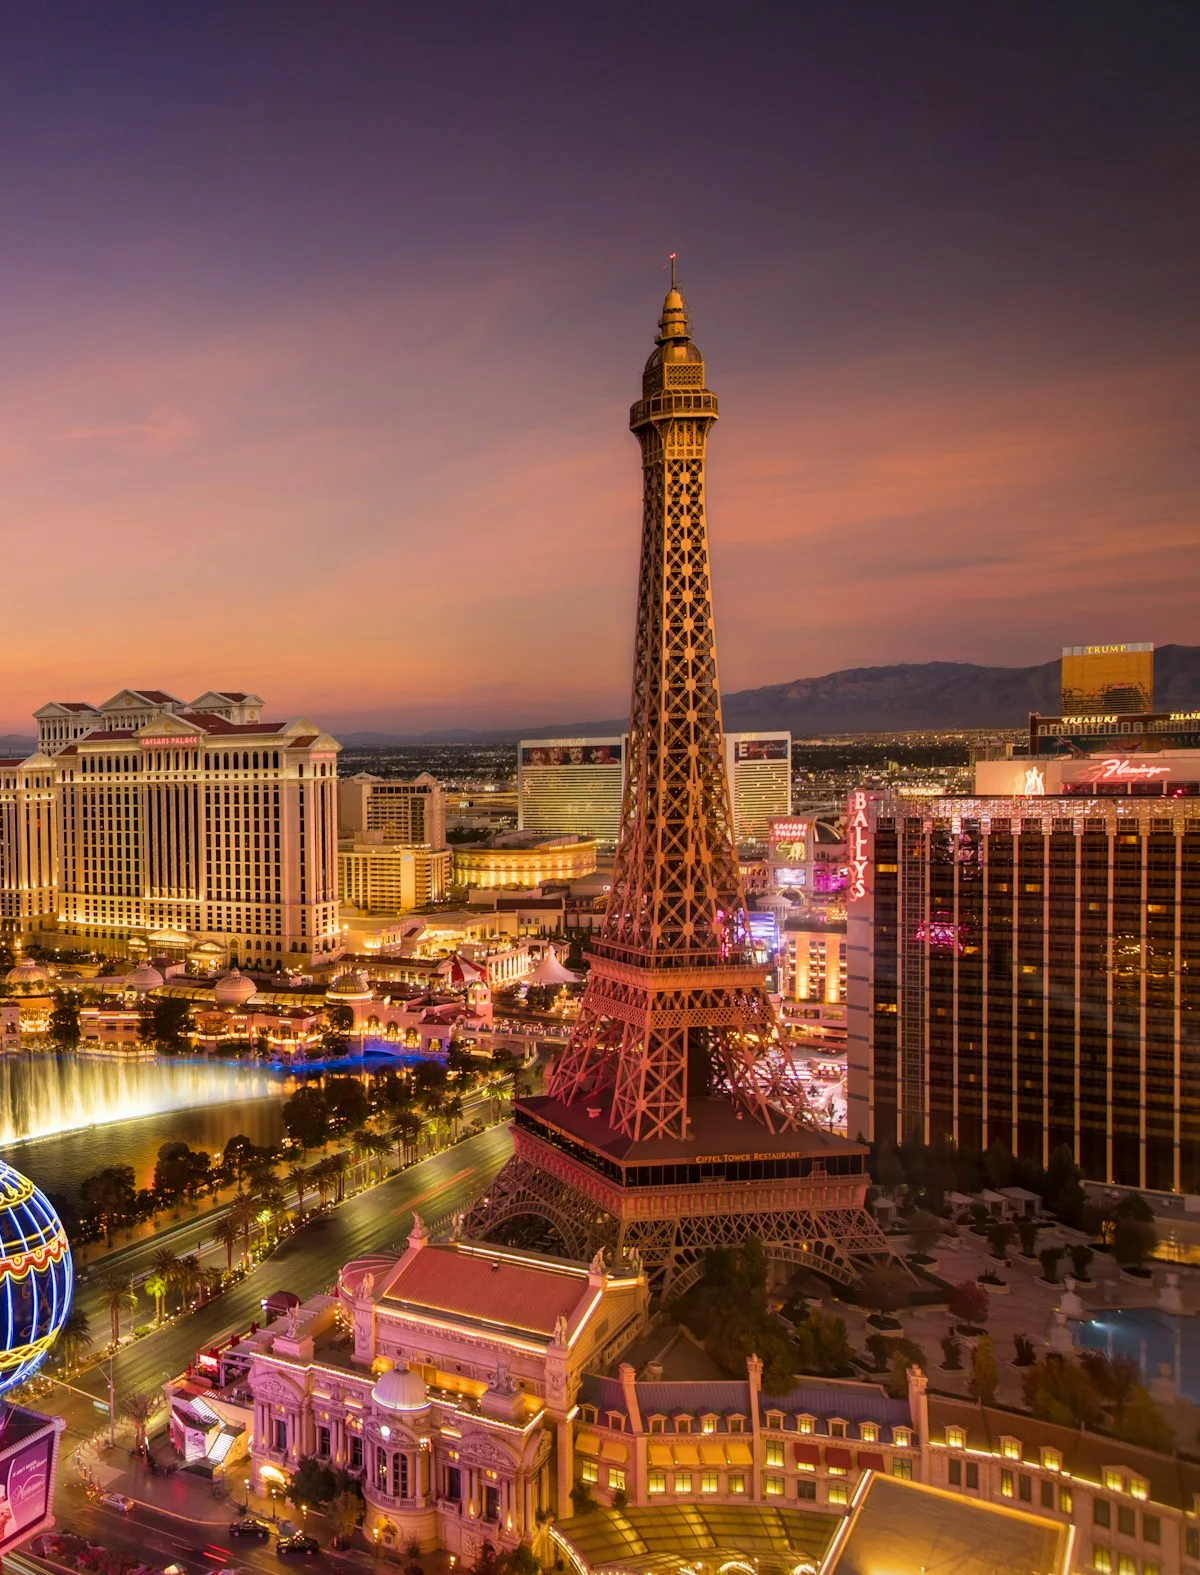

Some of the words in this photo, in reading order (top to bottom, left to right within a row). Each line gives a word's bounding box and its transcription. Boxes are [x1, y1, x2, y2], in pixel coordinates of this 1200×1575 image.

[1086, 645, 1126, 654] TRUMP
[1061, 715, 1118, 725] TREASURE
[171, 736, 197, 744] PALACE
[1101, 759, 1171, 778] Flamingo
[696, 1155, 721, 1164] EIFFEL
[723, 1154, 751, 1162] TOWER
[753, 1151, 801, 1161] RESTAURANT
